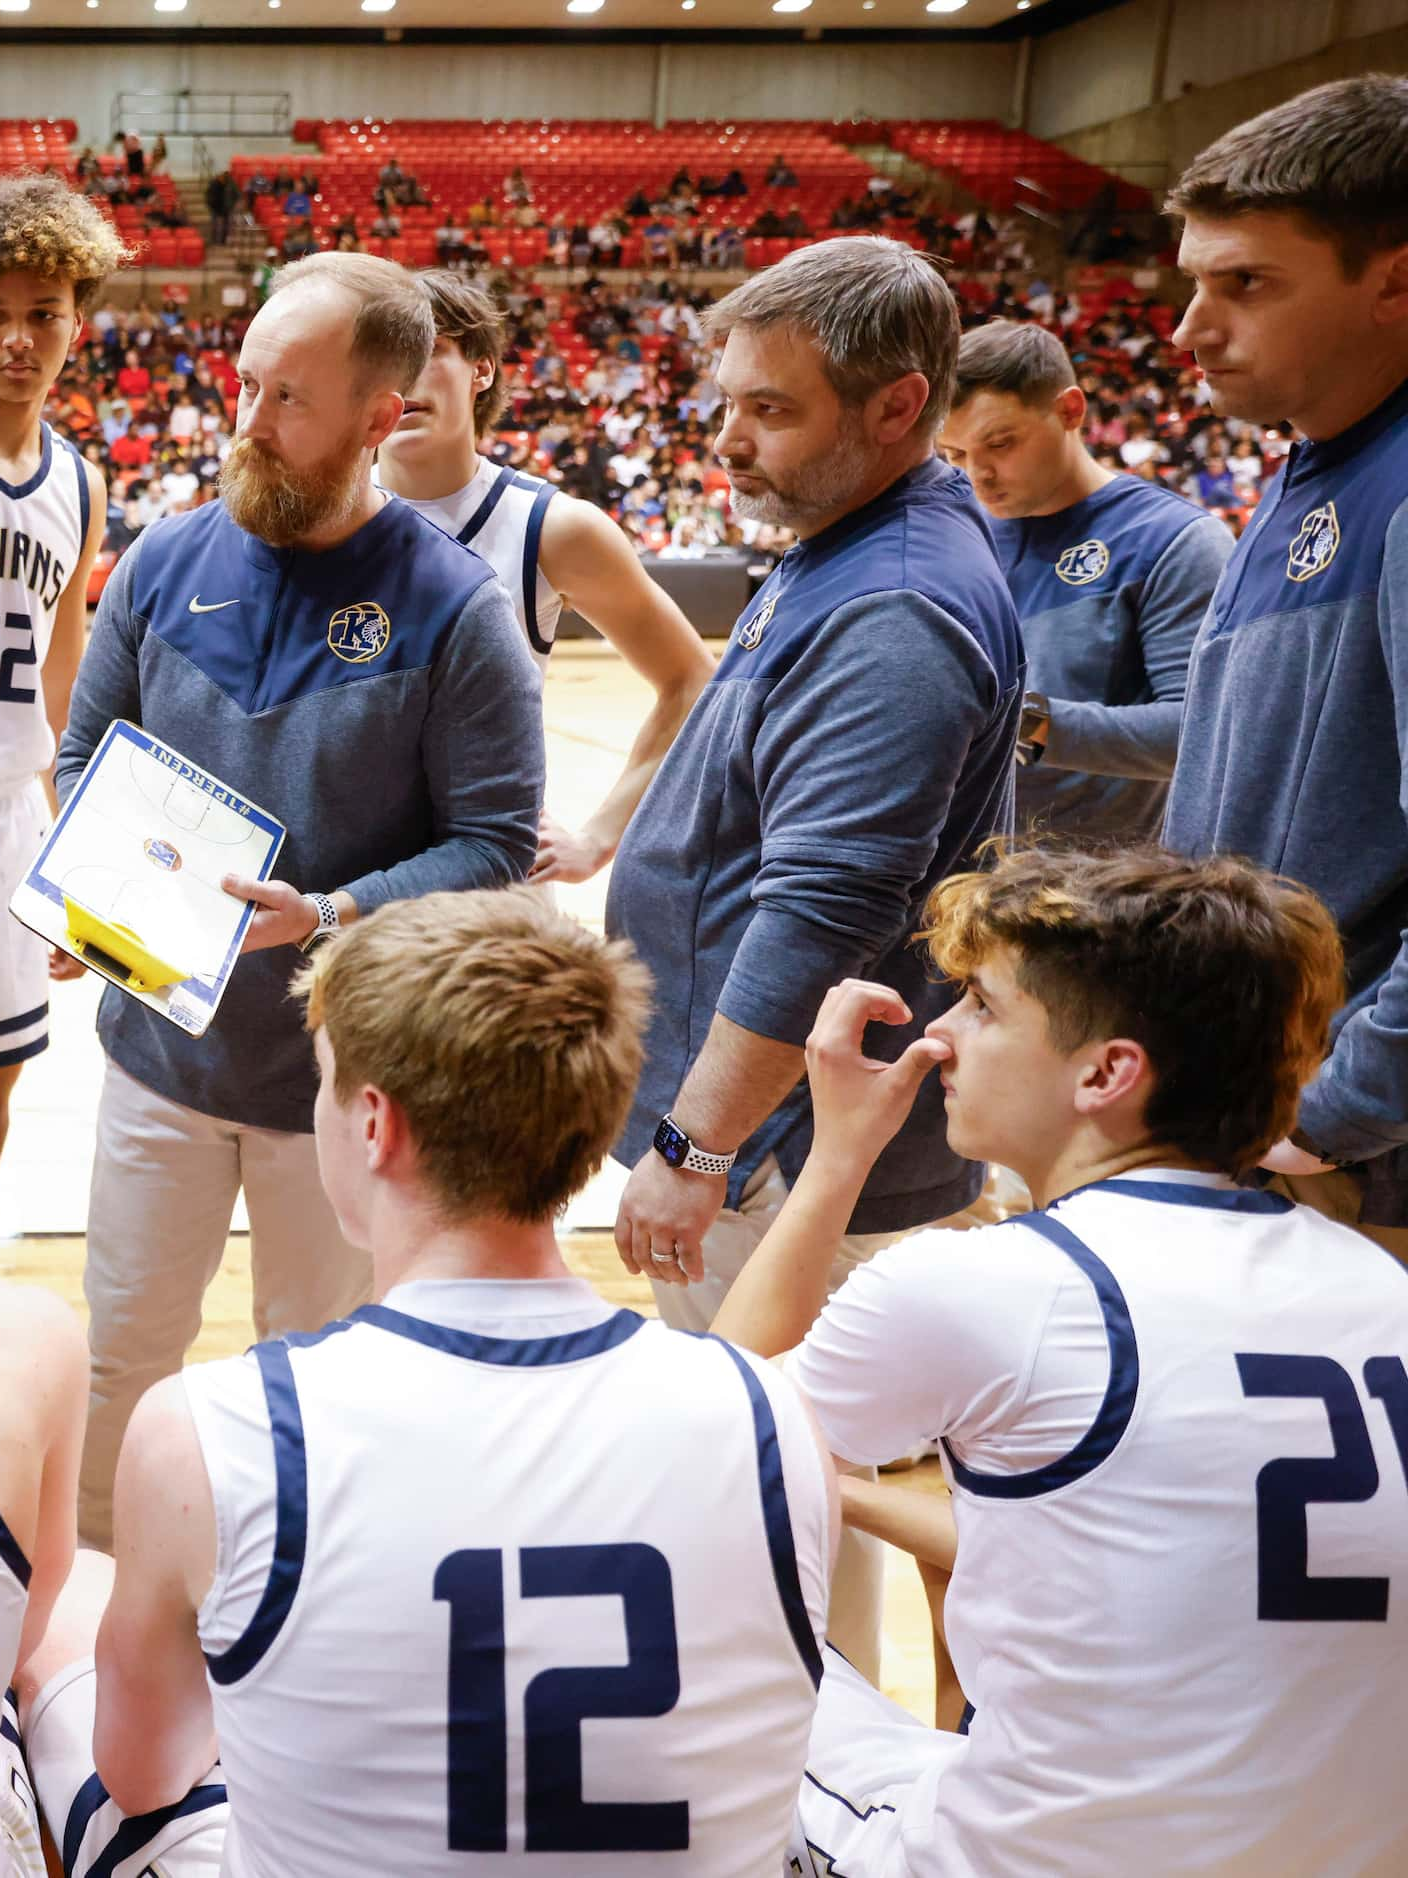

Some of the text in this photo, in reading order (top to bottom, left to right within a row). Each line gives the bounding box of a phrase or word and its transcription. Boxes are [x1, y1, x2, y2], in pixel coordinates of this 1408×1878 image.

[144, 741, 251, 816] #1PERCENT
[1234, 1352, 1408, 1624] 2
[433, 1542, 690, 1853] 12
